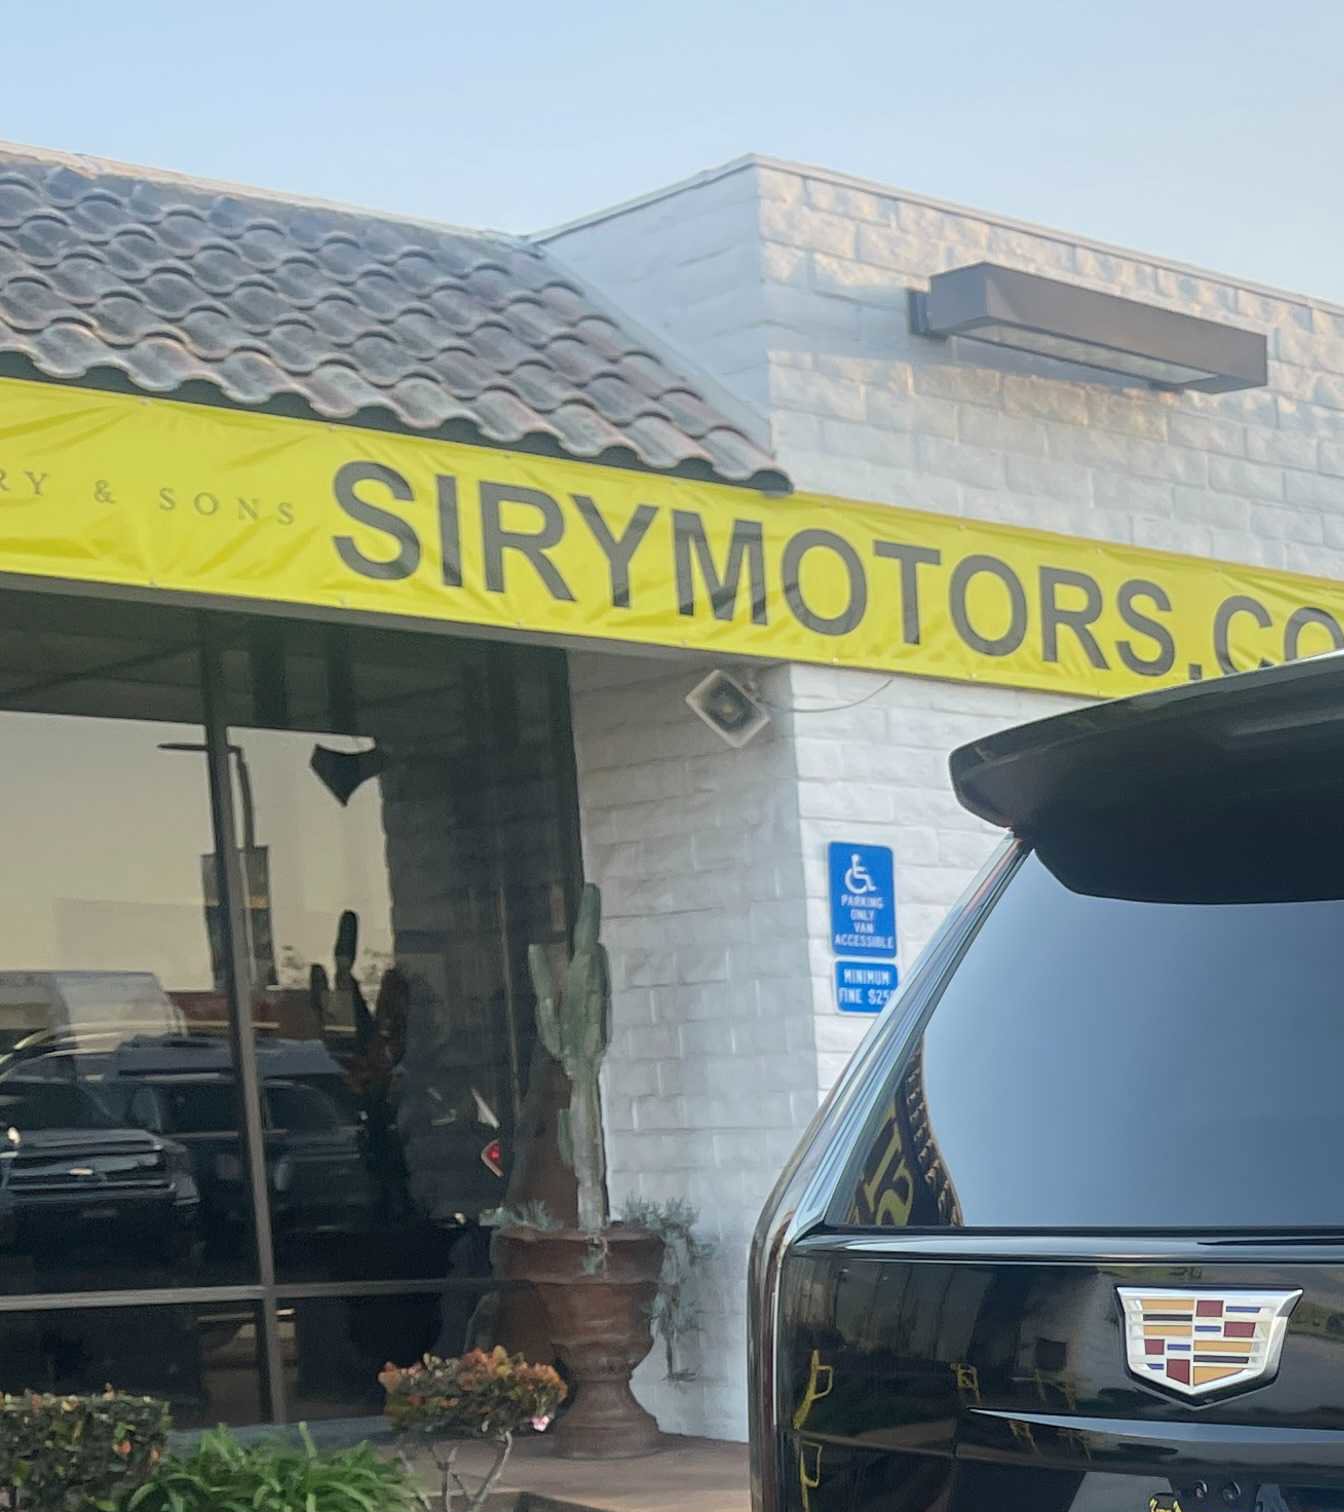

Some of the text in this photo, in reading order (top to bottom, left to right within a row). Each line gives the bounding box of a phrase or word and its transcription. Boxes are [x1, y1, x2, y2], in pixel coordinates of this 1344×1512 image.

[93, 479, 116, 504] &
[159, 487, 296, 527] SONS
[841, 894, 885, 909] PARKING
[850, 908, 876, 922] ONLY
[854, 921, 875, 934] VAN
[835, 934, 895, 950] ACCESSIBLE
[844, 968, 891, 986] MINIMUM
[839, 987, 895, 1006] FINE $25
